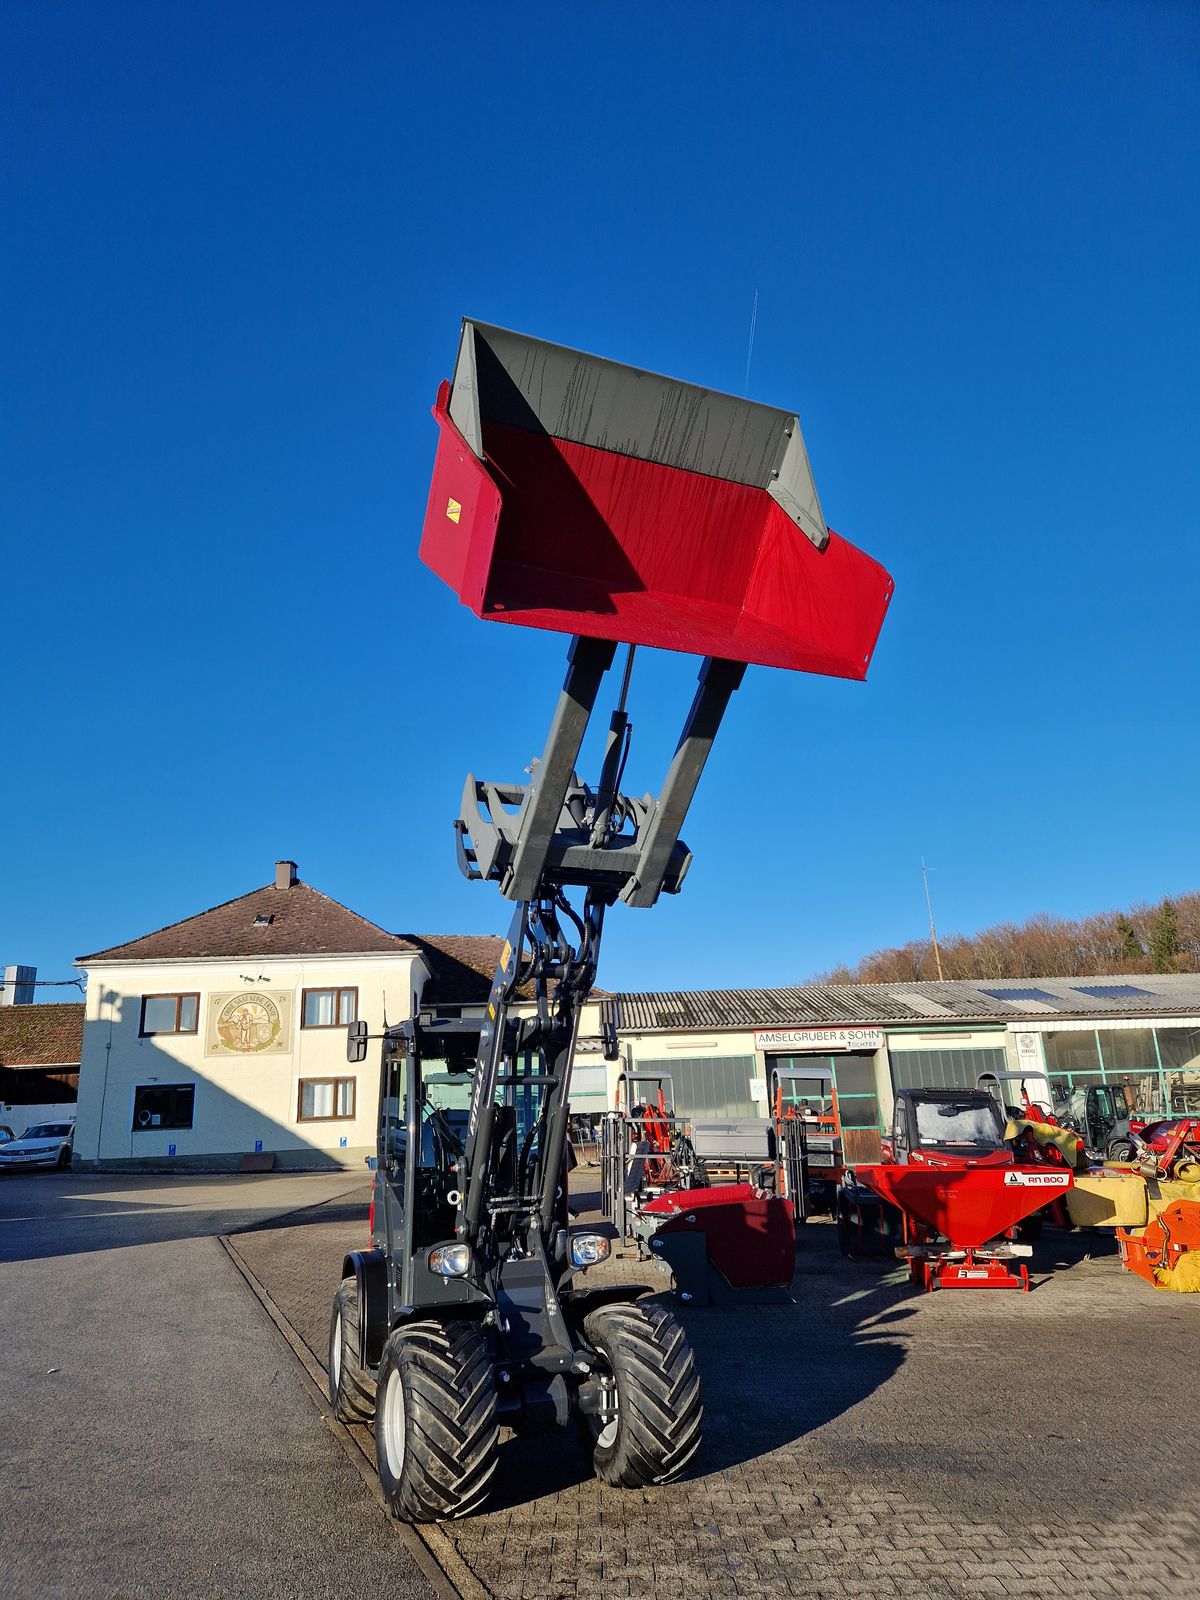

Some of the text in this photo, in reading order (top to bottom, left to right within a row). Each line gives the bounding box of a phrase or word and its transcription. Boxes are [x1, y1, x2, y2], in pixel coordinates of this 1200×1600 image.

[758, 1030, 880, 1042] AMSELGRUBER & SOHN
